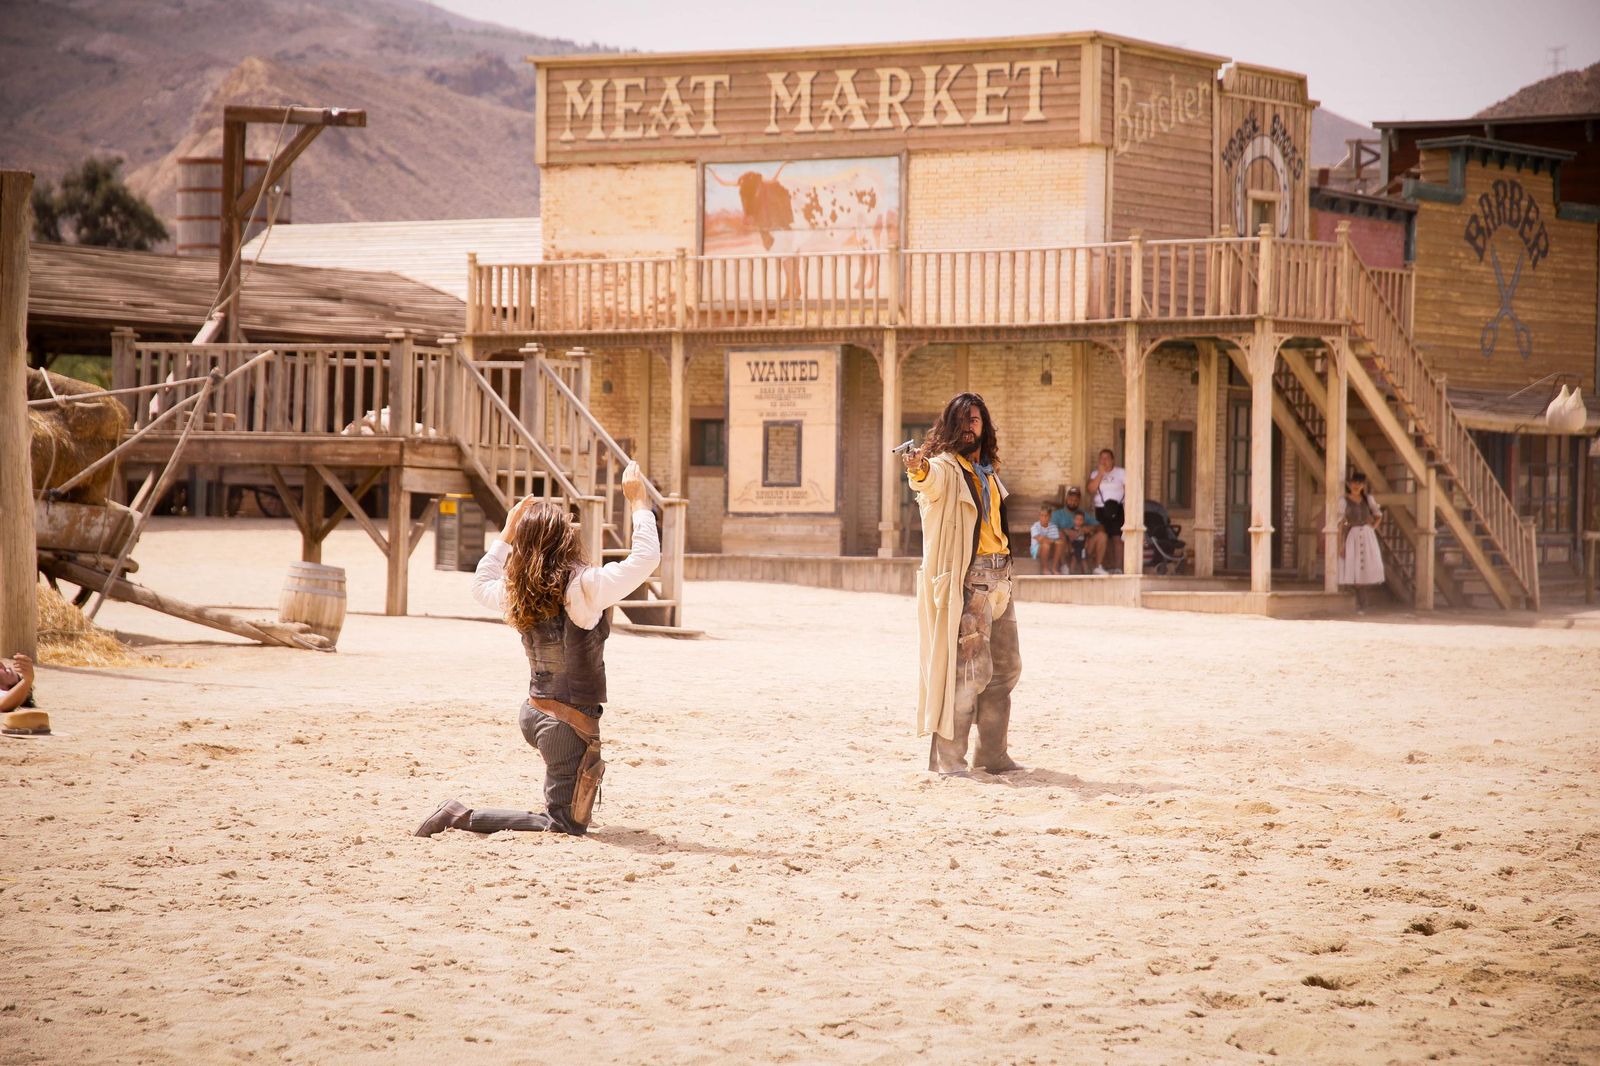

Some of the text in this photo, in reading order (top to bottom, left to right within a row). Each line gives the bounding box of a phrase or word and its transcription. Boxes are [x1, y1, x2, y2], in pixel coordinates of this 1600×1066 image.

[559, 59, 1060, 143] MEAT MARKET
[1113, 74, 1212, 156] Butcher
[1464, 179, 1549, 270] BARBER
[746, 360, 820, 382] WANTED
